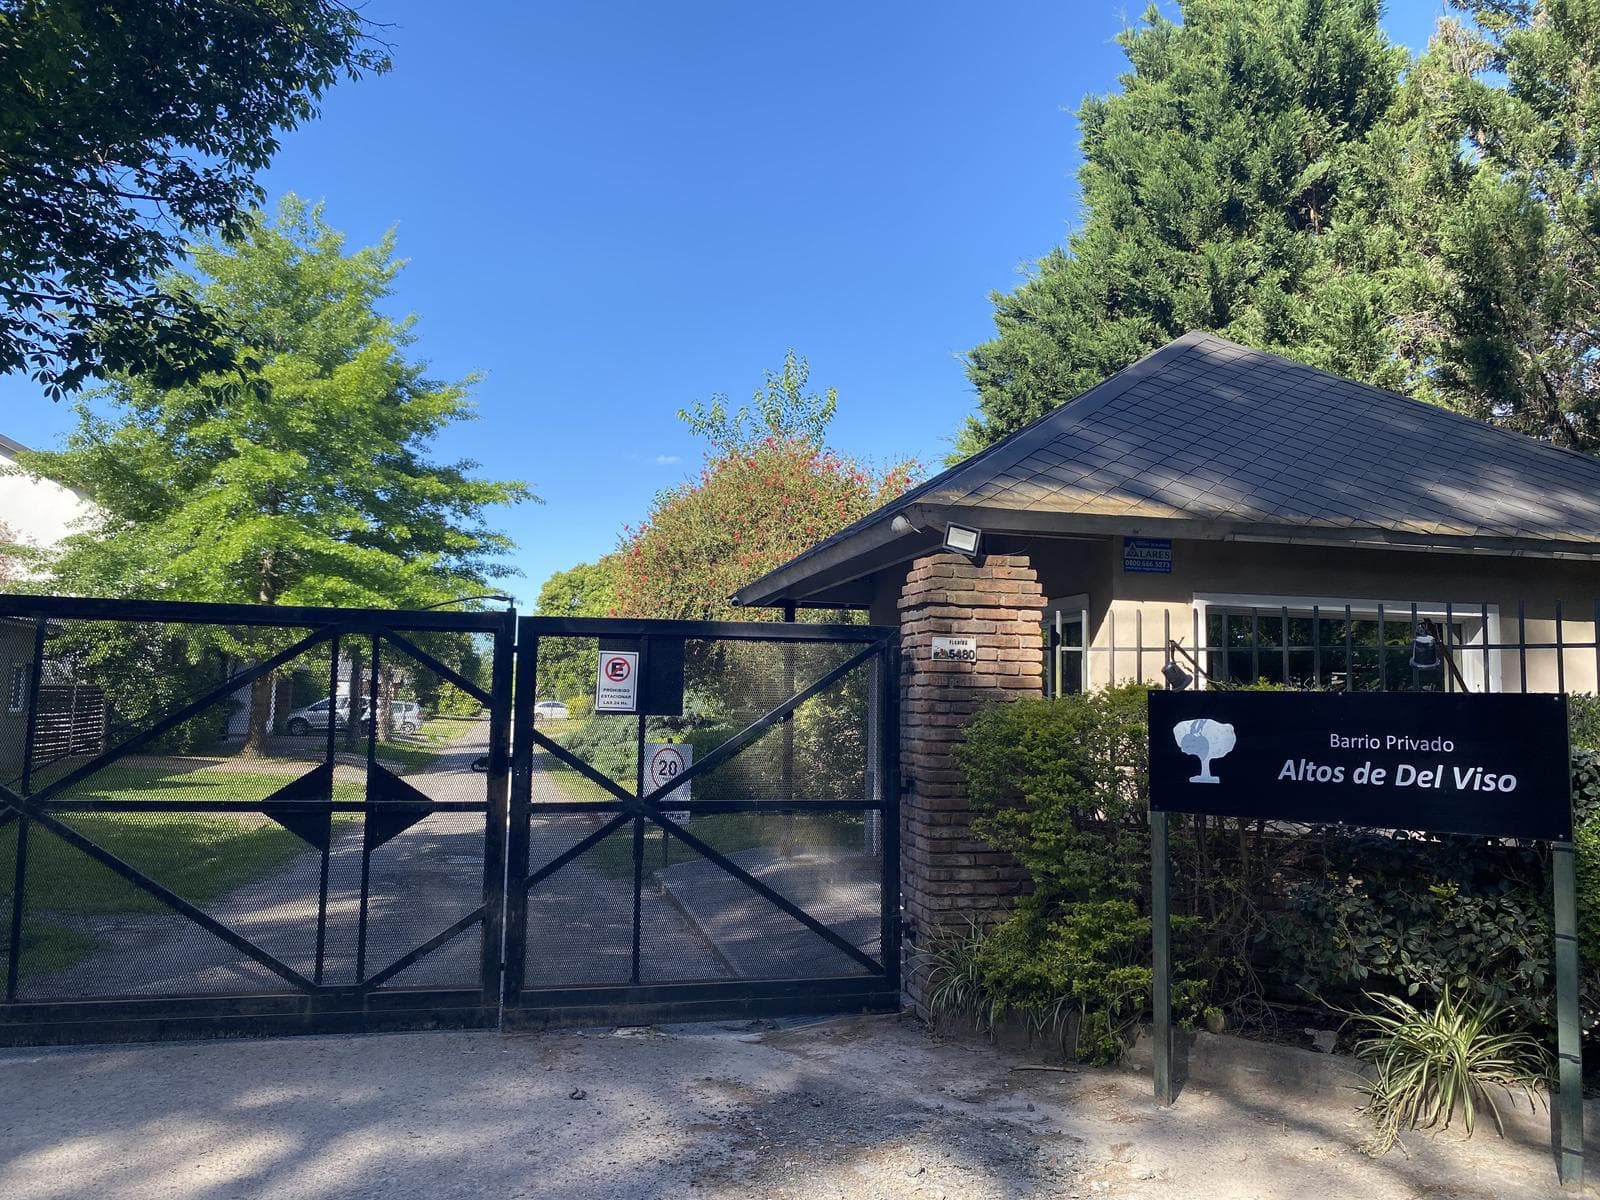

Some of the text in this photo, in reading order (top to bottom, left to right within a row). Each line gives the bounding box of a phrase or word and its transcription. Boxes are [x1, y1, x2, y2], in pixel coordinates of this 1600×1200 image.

[1330, 733, 1455, 752] Barrio Privado
[659, 760, 677, 776] 20
[1278, 758, 1517, 793] Altos de Del Viso
